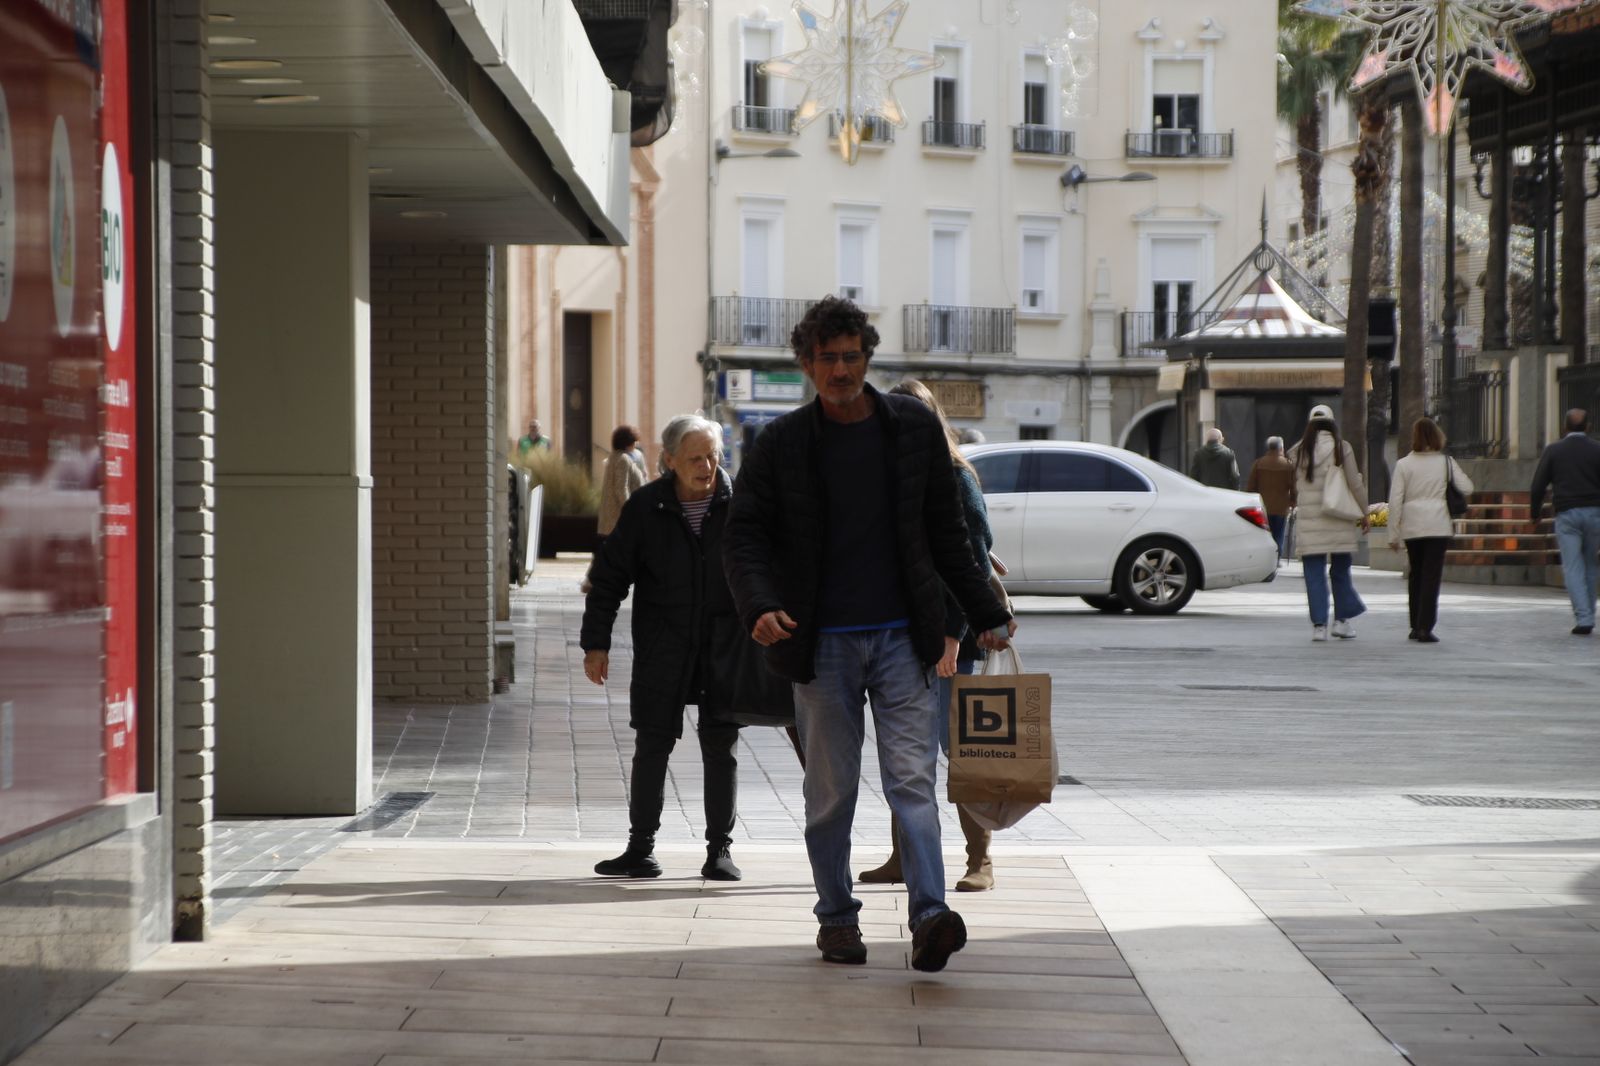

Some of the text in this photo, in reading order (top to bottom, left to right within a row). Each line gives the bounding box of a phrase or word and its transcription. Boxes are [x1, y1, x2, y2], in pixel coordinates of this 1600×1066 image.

[102, 208, 121, 284] BIO
[973, 700, 1002, 732] b
[959, 748, 1017, 759] biblioteca
